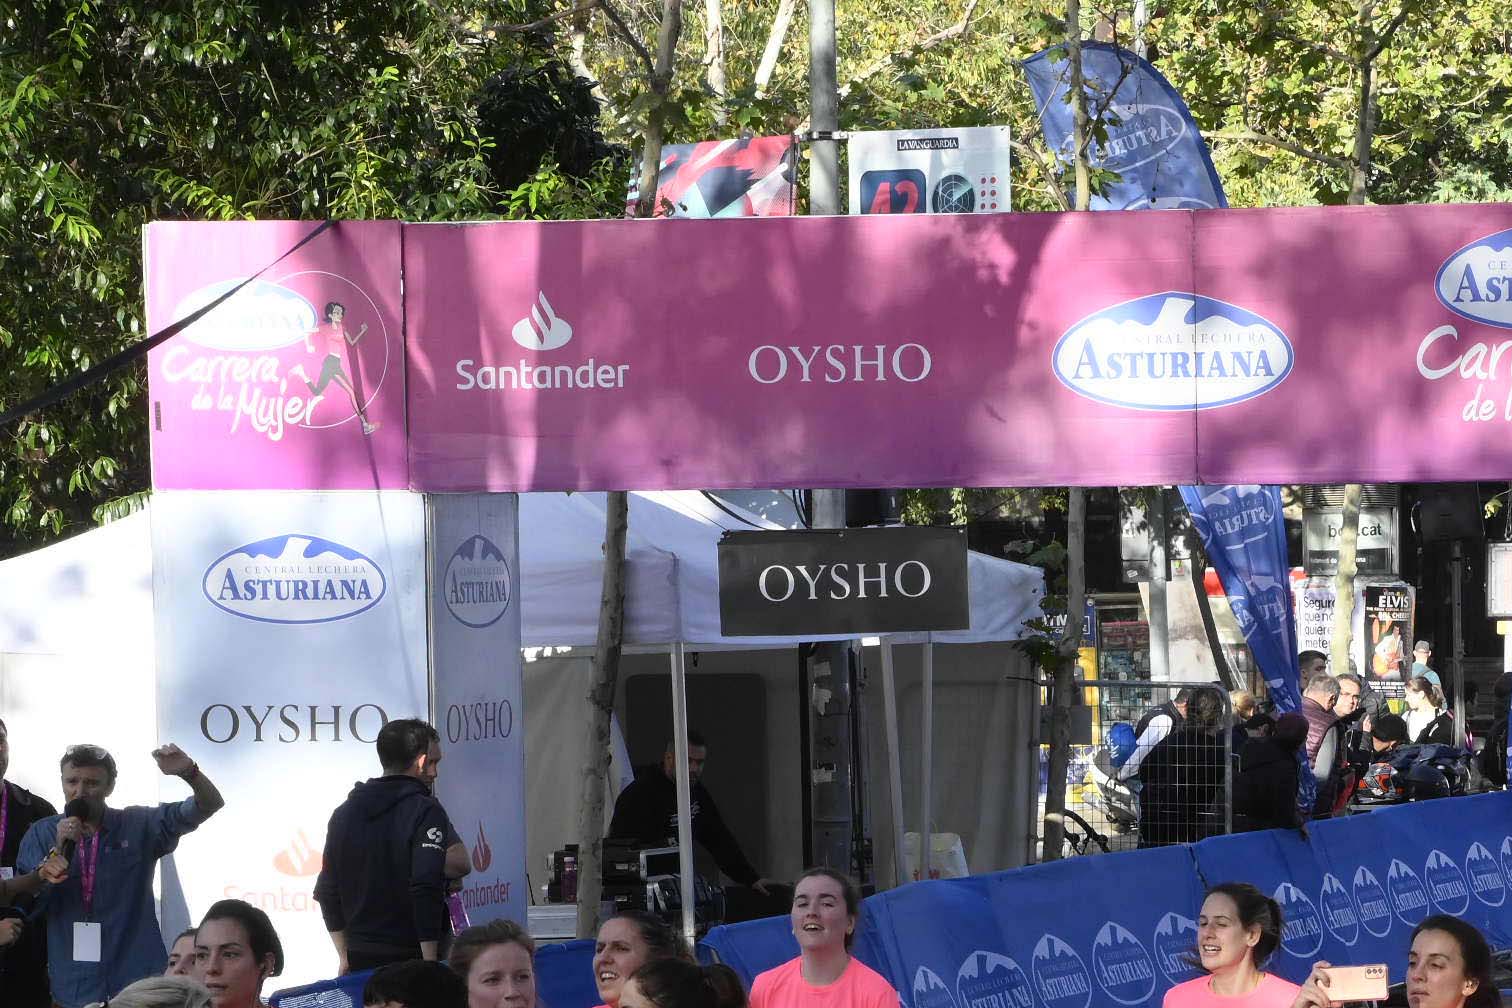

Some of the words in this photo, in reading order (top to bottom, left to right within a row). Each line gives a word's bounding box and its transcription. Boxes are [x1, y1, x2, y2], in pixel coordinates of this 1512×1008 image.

[908, 138, 957, 150] VANGUARDIA
[161, 346, 280, 384] Carrera
[456, 358, 630, 390] Santander
[748, 343, 931, 384] OYSHO
[1072, 337, 1275, 380] ASTURIANA
[231, 379, 325, 440] Mujer
[1462, 384, 1496, 422] de
[217, 567, 373, 602] ASTURIANA
[449, 568, 507, 605] ASTURIANA
[758, 560, 931, 602] OYSHO
[1379, 595, 1409, 608] ELVIS
[200, 703, 389, 744] OYSHO
[447, 700, 513, 744] OYSHO
[462, 877, 511, 909] antander
[1101, 959, 1153, 988] ASTURIANA
